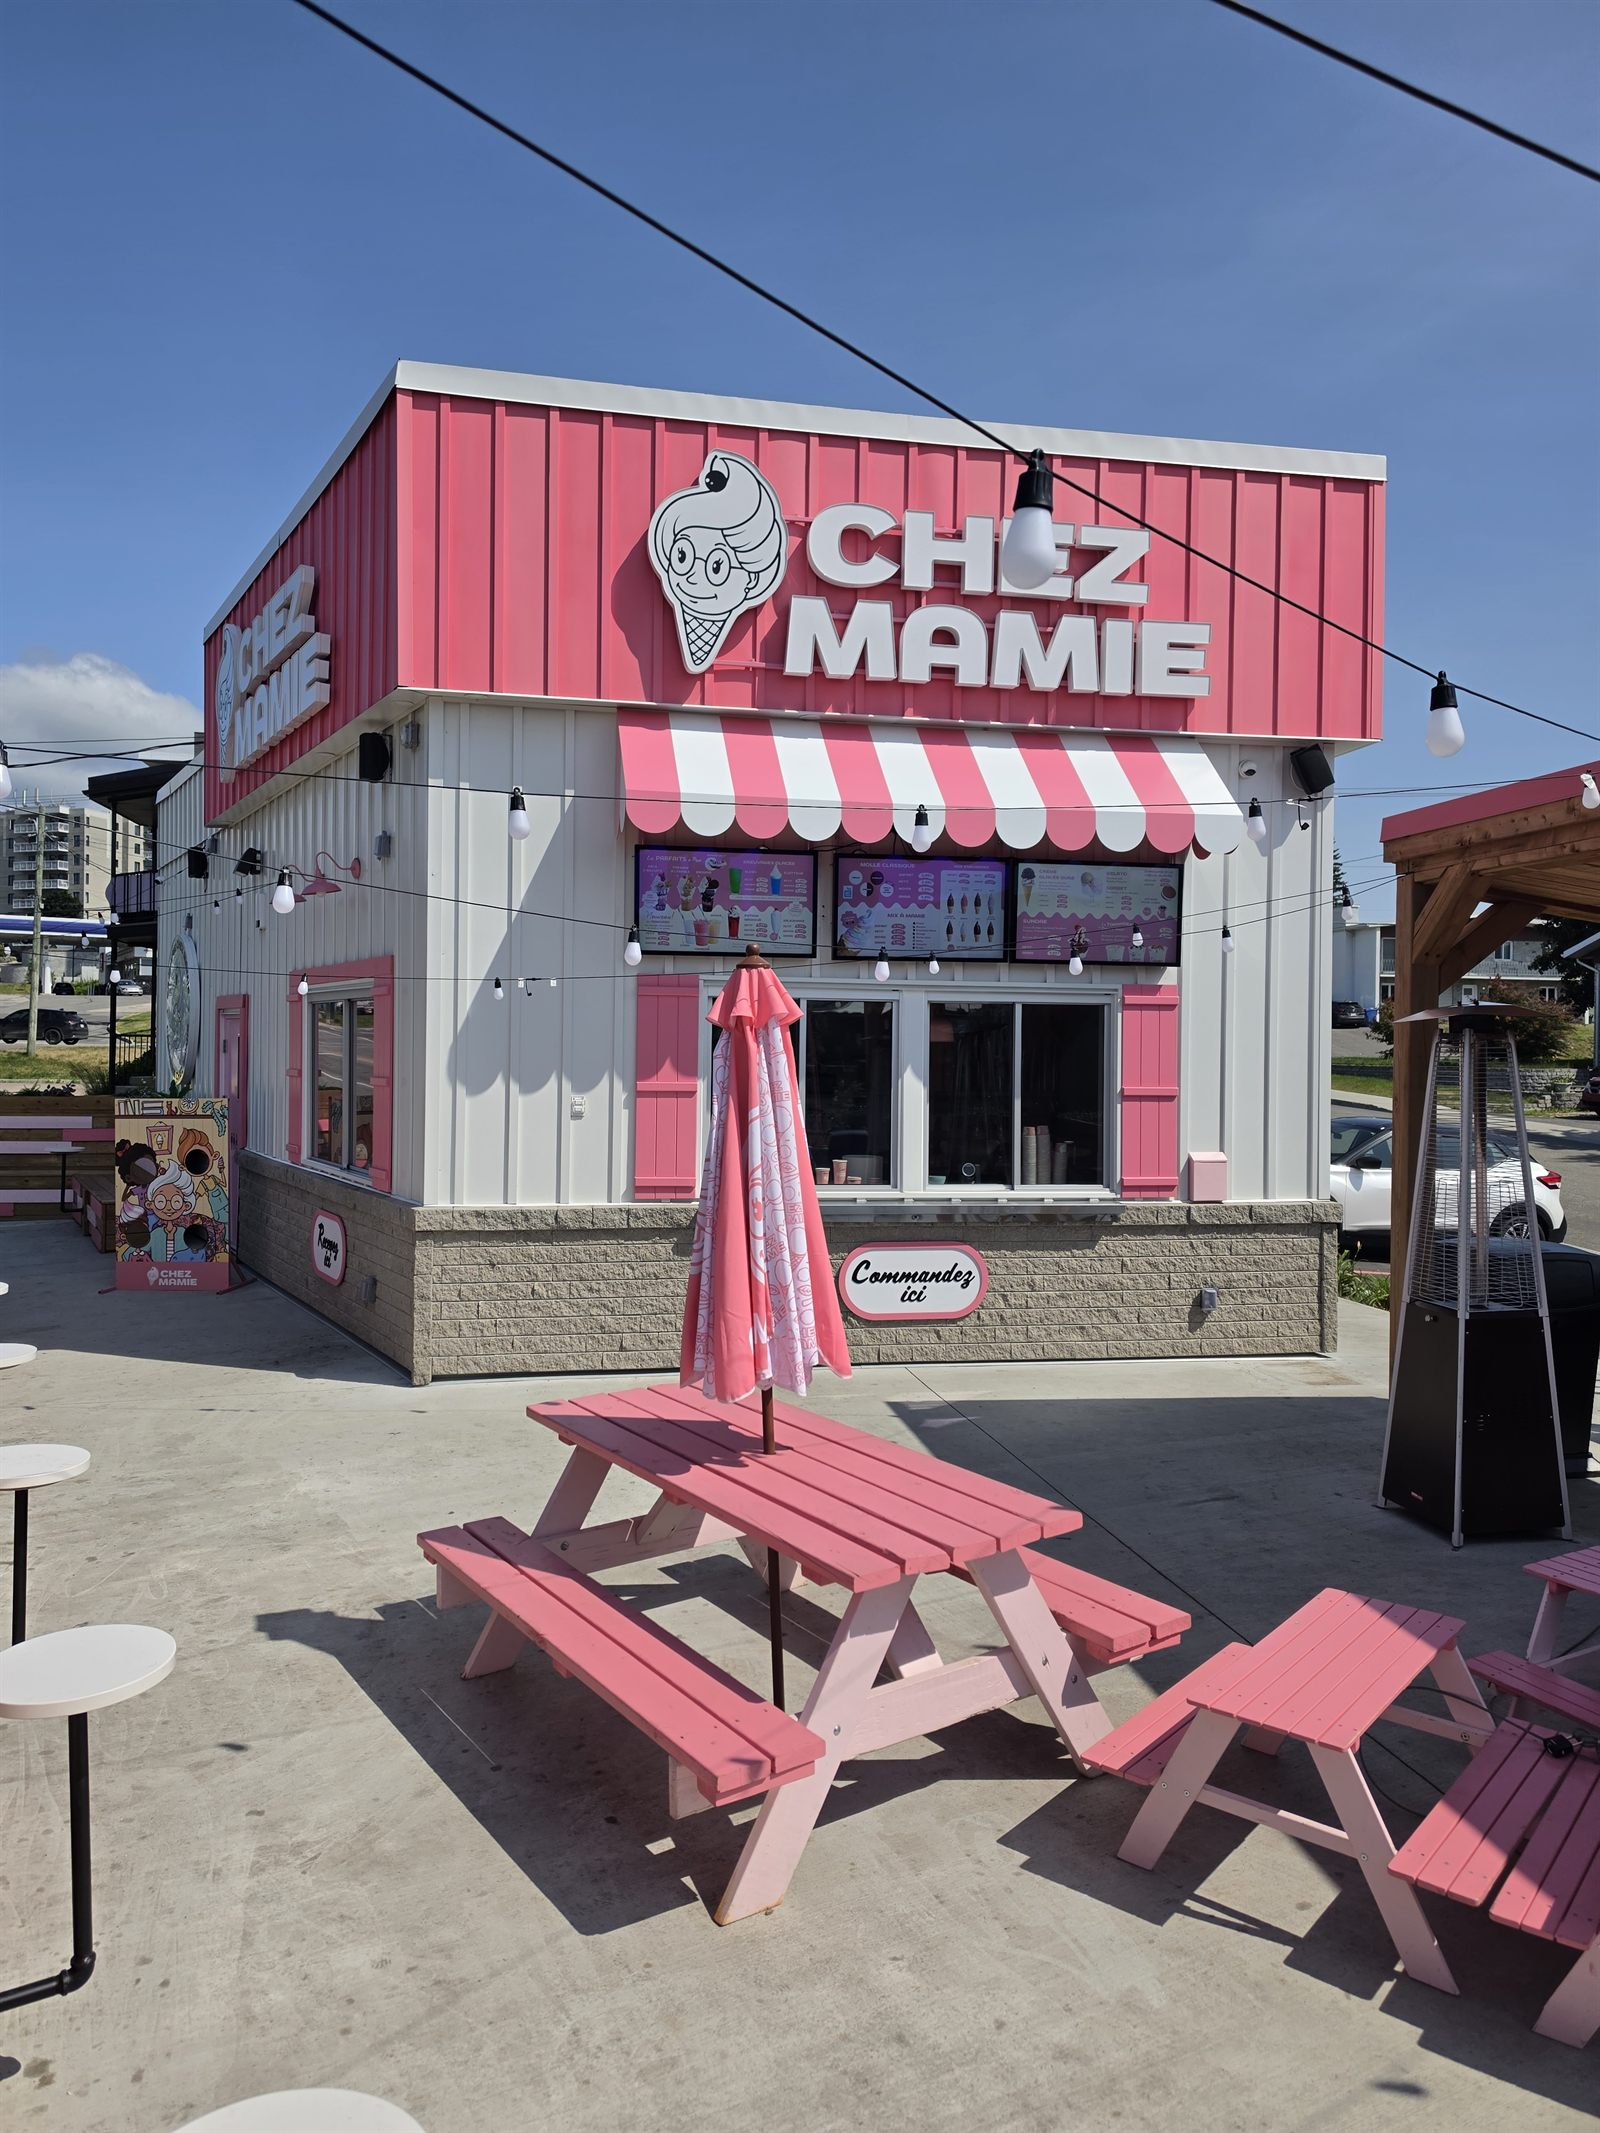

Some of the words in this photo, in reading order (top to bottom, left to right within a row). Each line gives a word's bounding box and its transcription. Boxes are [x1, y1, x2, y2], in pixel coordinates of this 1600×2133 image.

[806, 501, 1151, 608] CHEZ
[236, 564, 315, 693] CHEZ
[782, 594, 1212, 699] MAMIE
[233, 631, 331, 769] MAMIE
[158, 1277, 198, 1286] MAMIE
[160, 1269, 192, 1278] CHEZ
[851, 1259, 976, 1290] Commandez
[900, 1285, 927, 1303] ici
